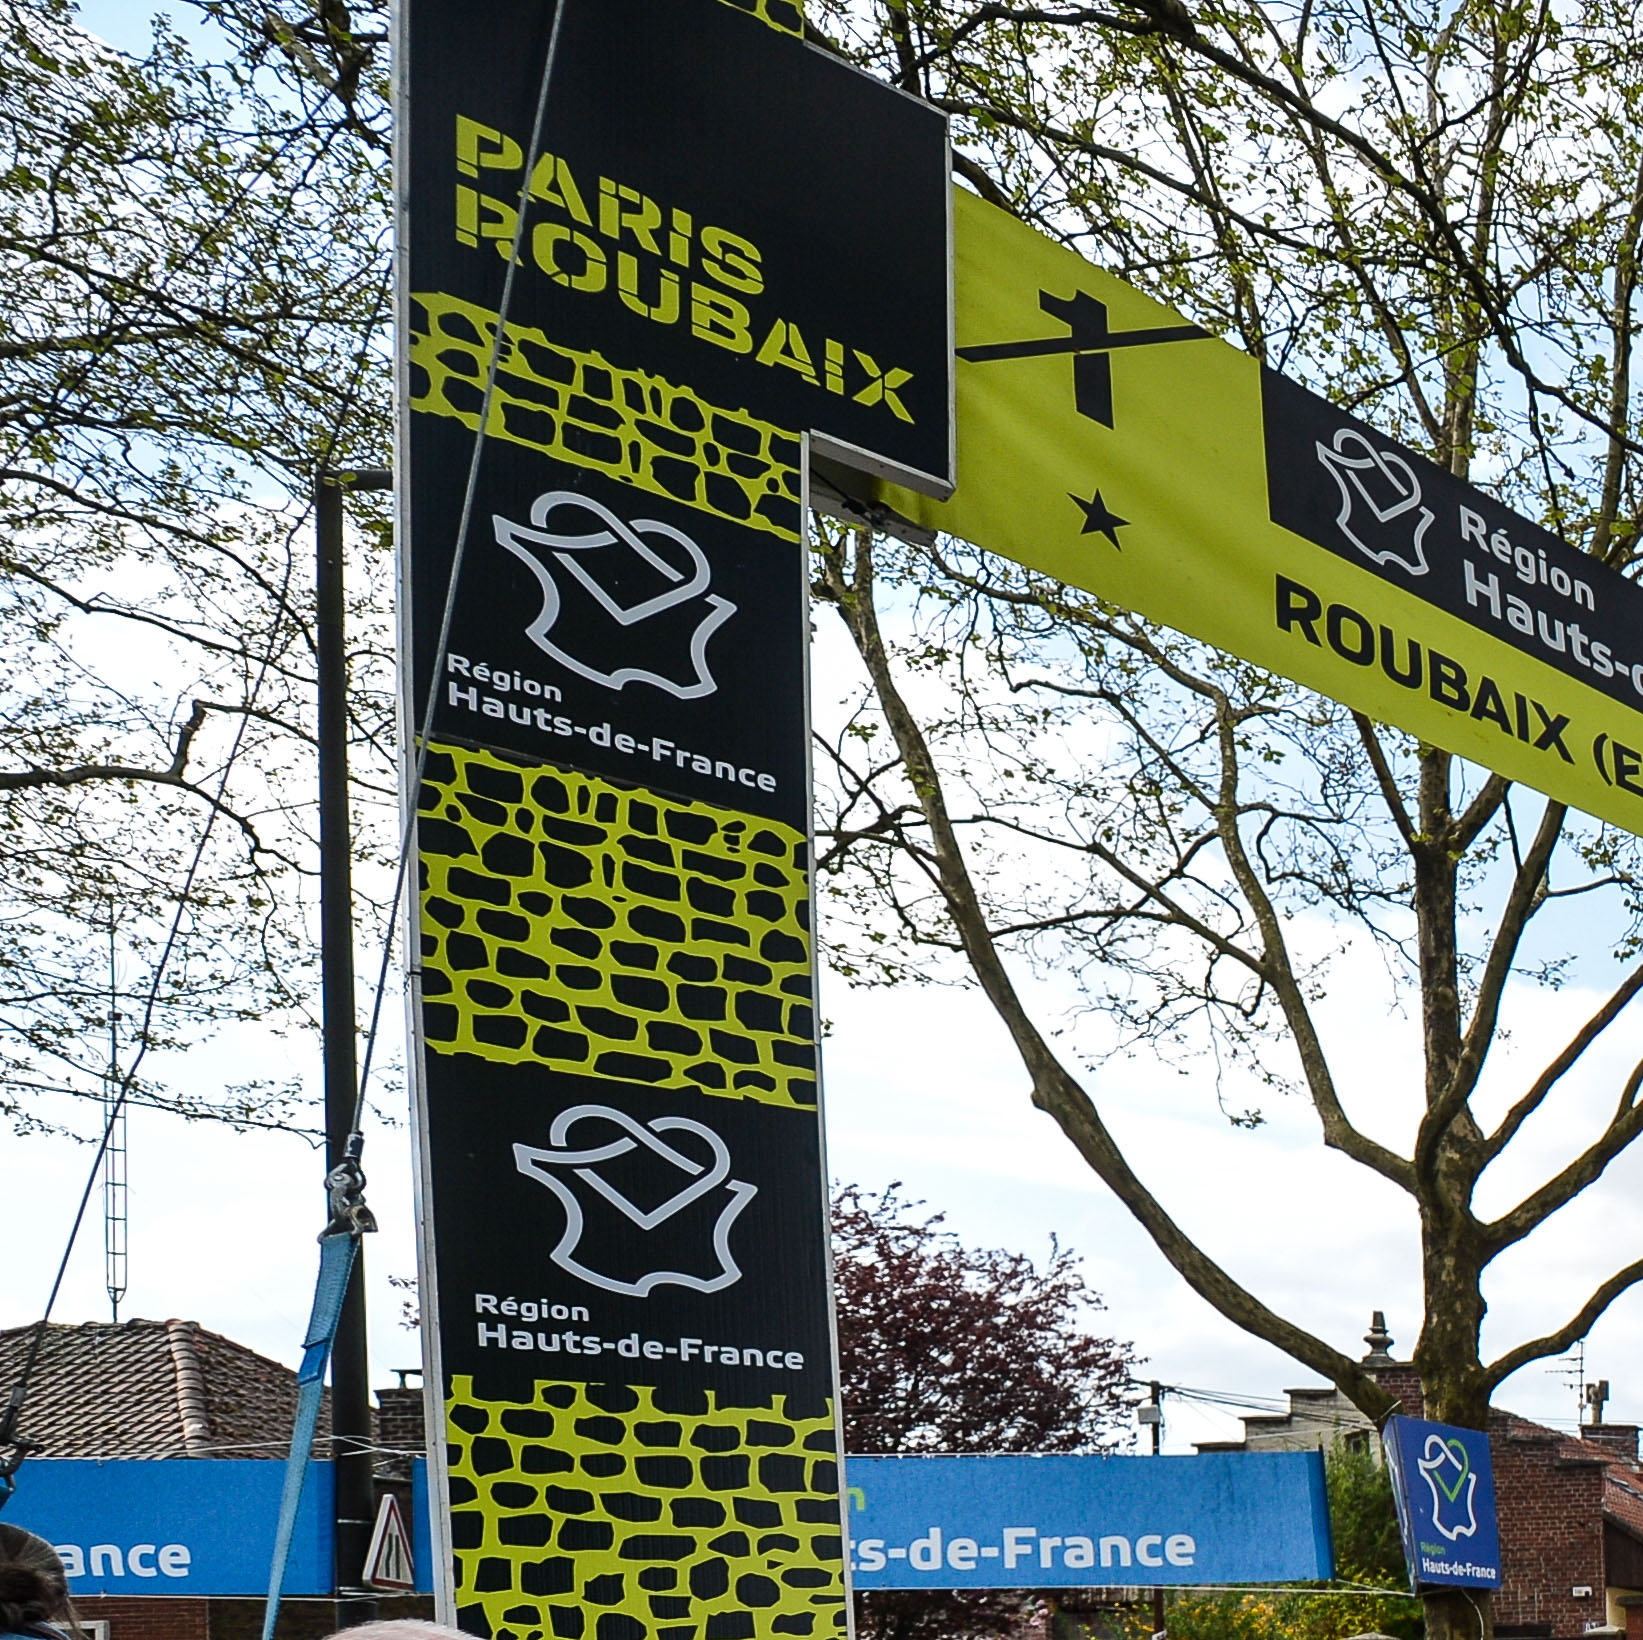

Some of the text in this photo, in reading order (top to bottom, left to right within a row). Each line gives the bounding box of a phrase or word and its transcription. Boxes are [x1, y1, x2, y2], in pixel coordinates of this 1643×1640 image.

[456, 114, 765, 295] PARIS
[456, 184, 915, 425] ROUBAIX
[1459, 504, 1594, 612] Région
[447, 653, 562, 703] Région
[1275, 573, 1575, 765] ROUBAIX
[448, 681, 777, 793] Hauts-de-France
[475, 1293, 589, 1323] Région
[477, 1323, 804, 1371] Hauts-de-France
[60, 1543, 191, 1577] ance
[1422, 1557, 1496, 1579] Hauts-de-France
